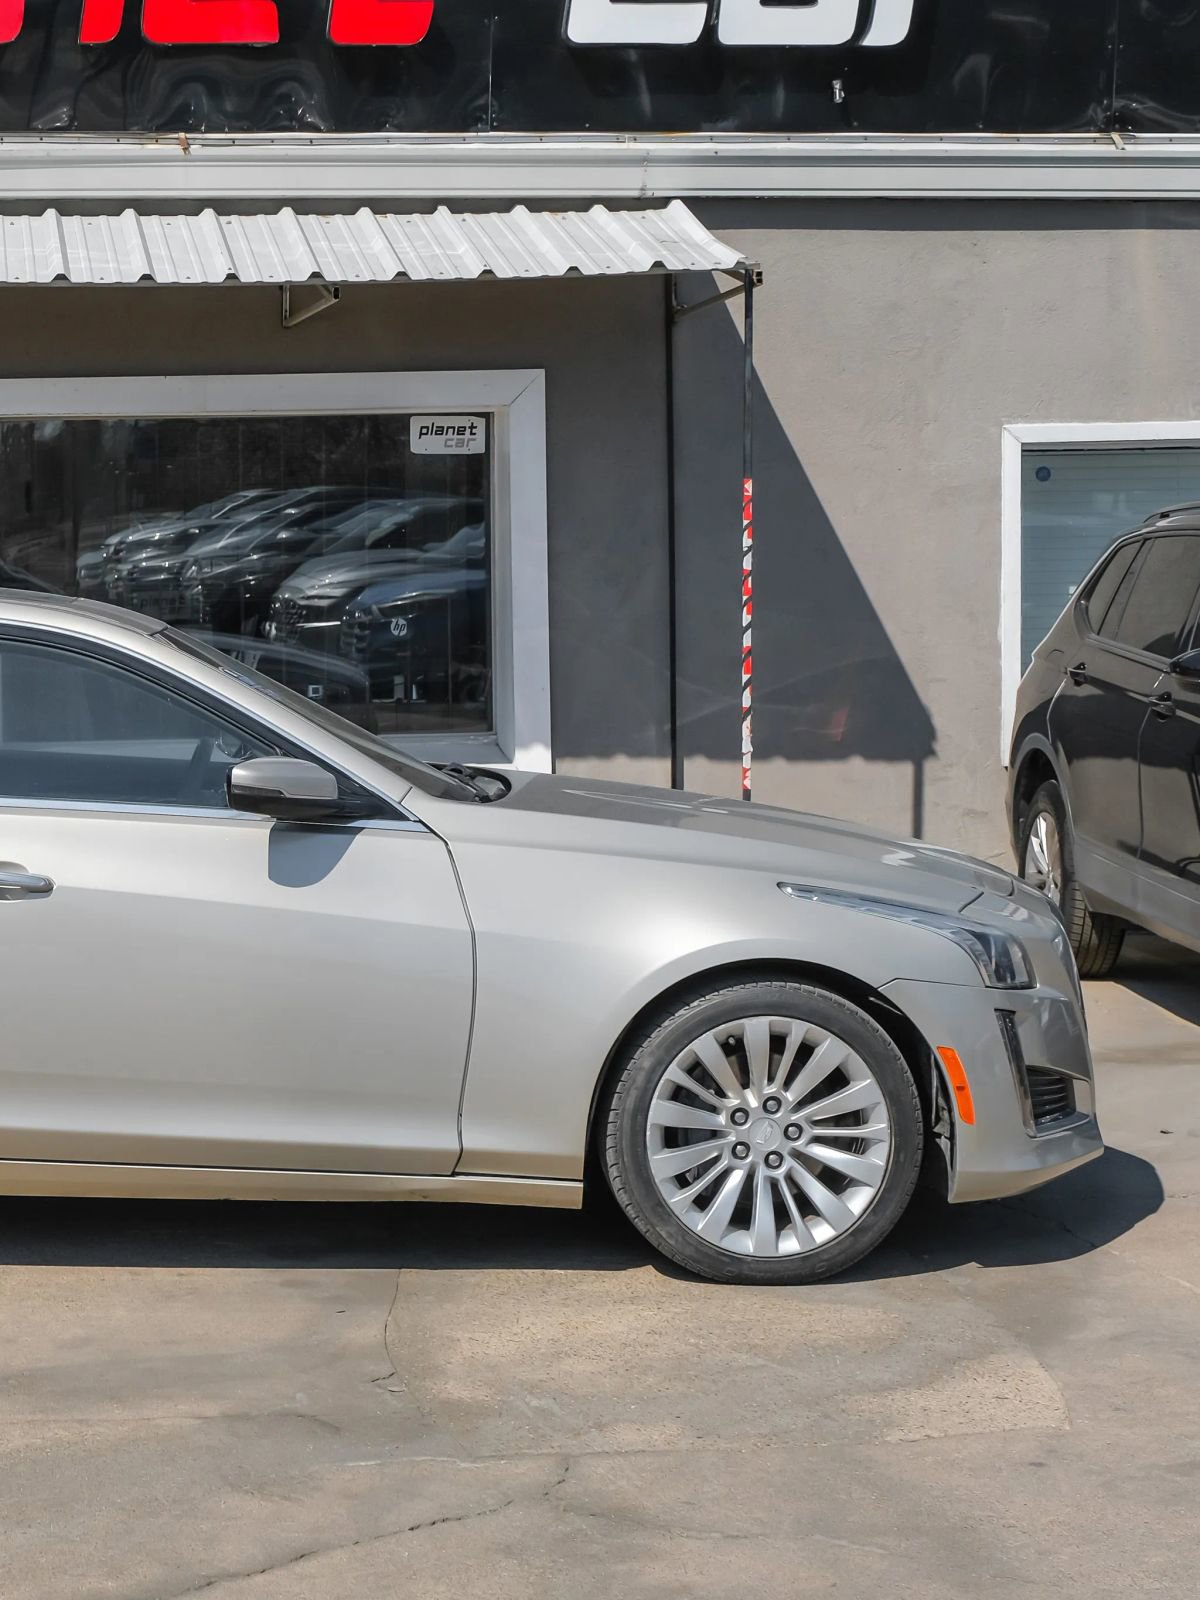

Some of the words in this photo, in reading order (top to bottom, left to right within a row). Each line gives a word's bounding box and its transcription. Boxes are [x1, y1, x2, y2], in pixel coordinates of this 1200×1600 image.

[418, 422, 478, 440] planet
[443, 438, 477, 448] car
[392, 618, 407, 636] hp
